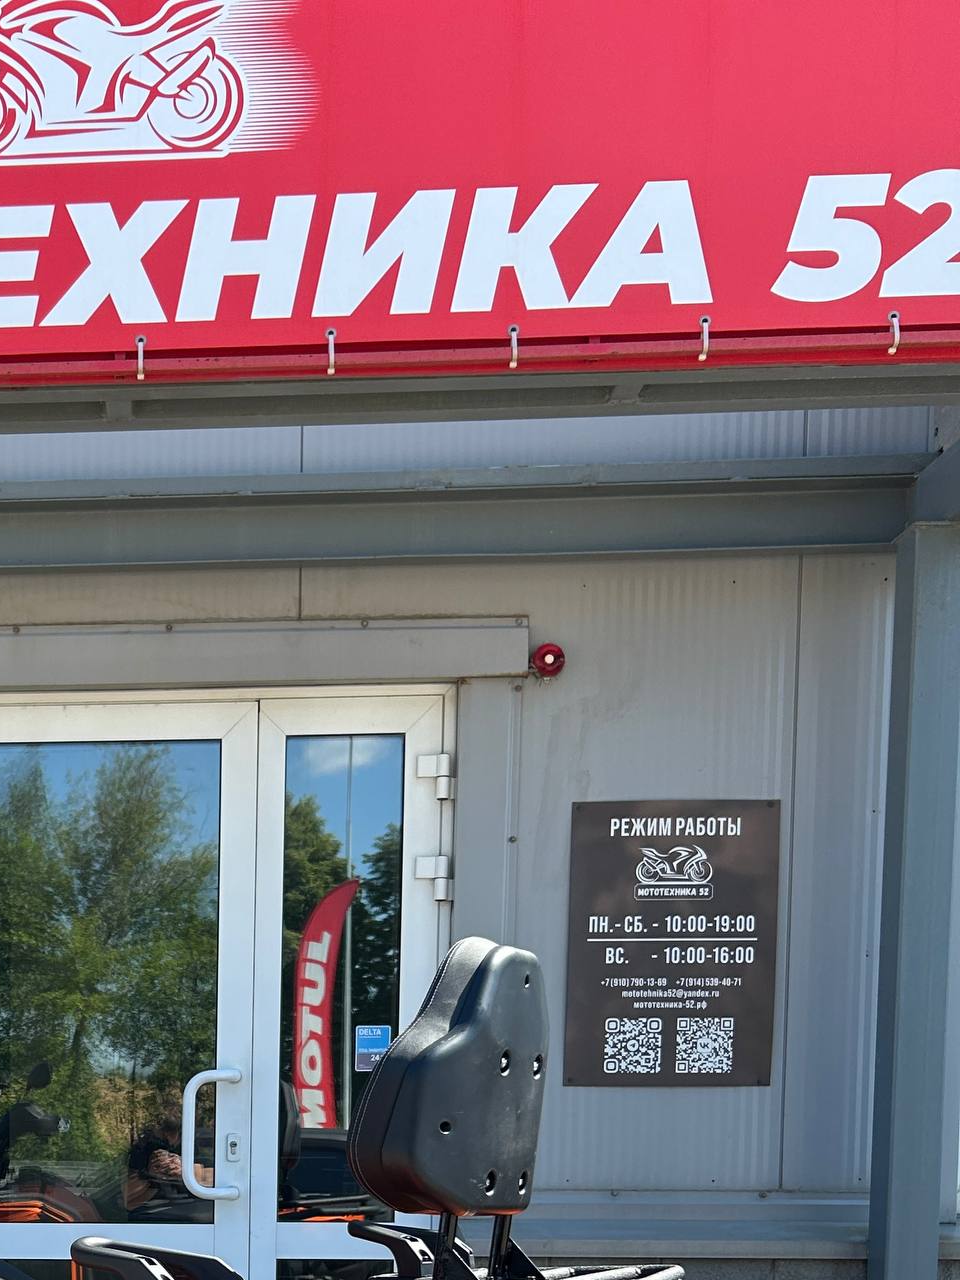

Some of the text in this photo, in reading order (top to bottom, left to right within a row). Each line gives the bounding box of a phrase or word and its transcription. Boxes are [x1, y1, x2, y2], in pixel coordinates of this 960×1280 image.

[769, 167, 960, 303] 52
[610, 817, 741, 837] РЕЖИМ РАБОТЫ
[637, 887, 709, 897] МОТОТЕХНИКА 52
[664, 915, 755, 933] 10:00-19:00
[605, 947, 629, 964] ВС.
[664, 947, 755, 964] 10:00-16:00
[300, 931, 332, 1129] MOTUL
[358, 1028, 382, 1036] DELTA
